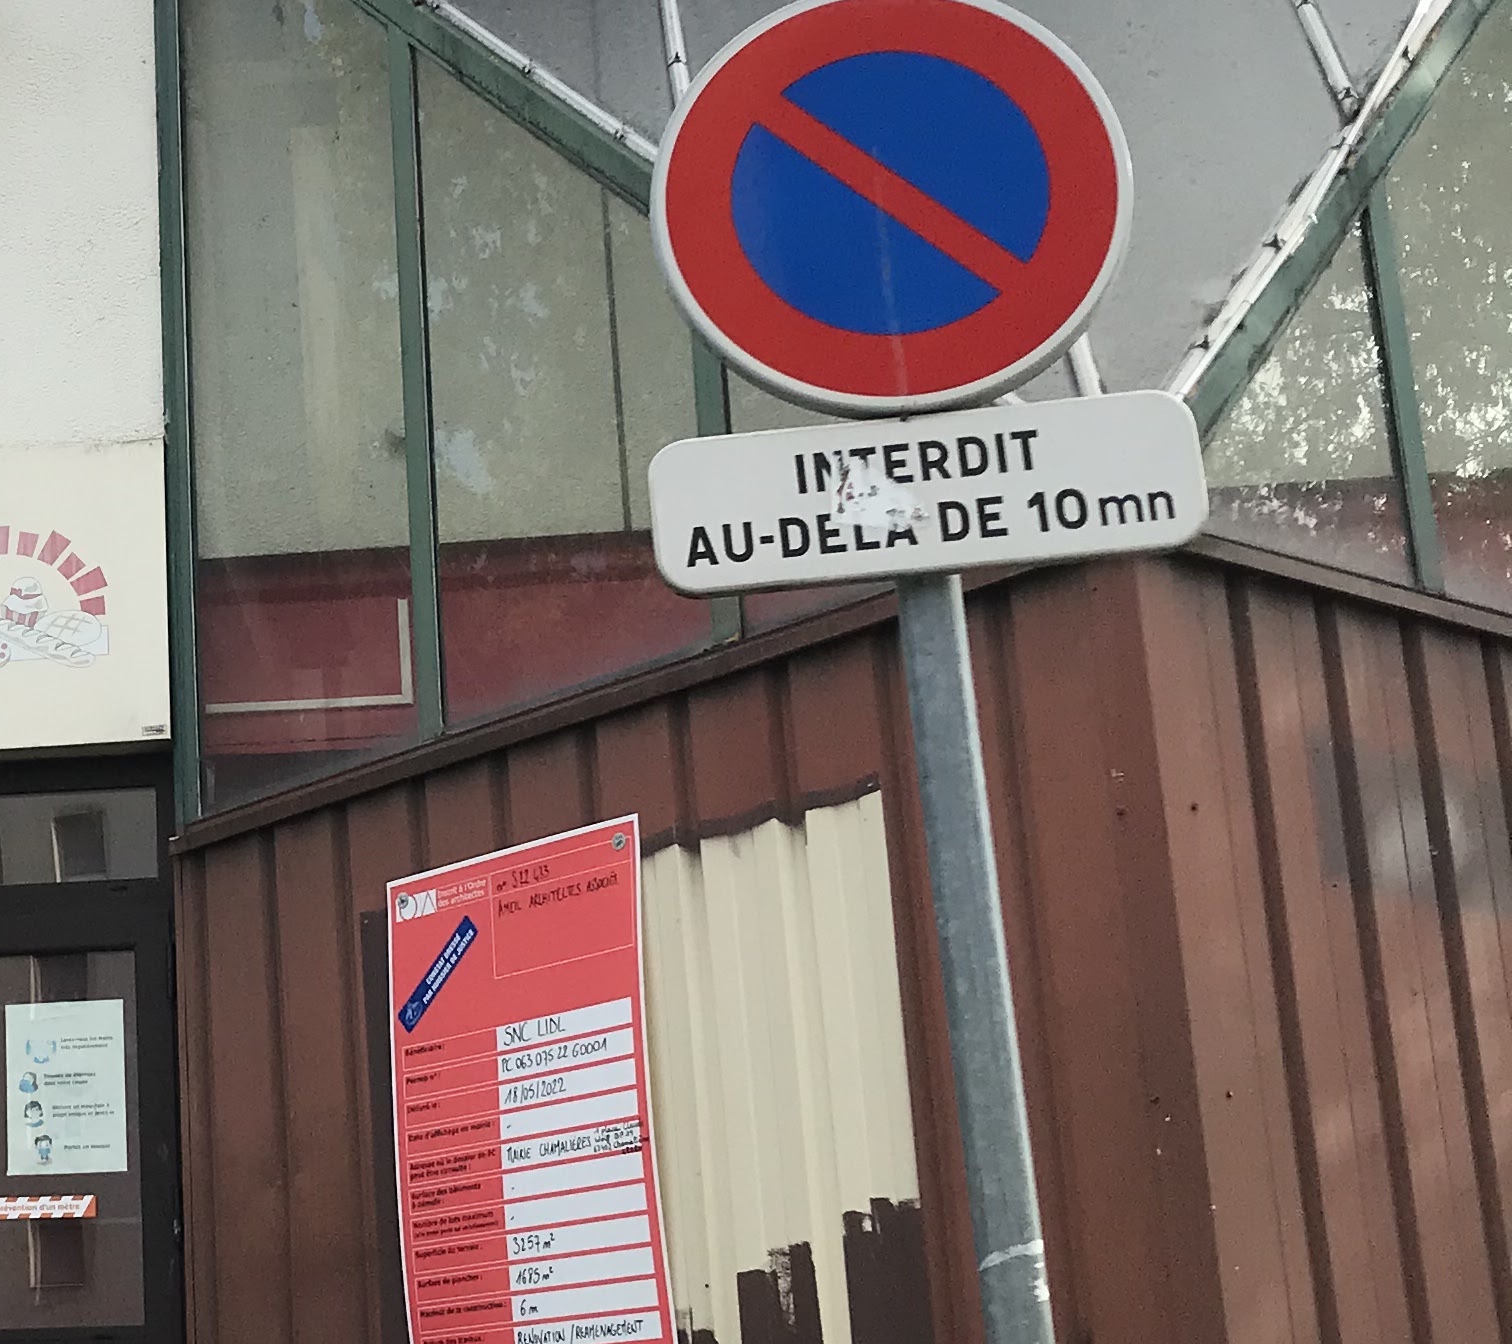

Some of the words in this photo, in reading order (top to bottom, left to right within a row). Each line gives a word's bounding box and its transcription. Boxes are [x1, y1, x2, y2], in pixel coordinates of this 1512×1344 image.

[938, 495, 1008, 543] DE
[503, 1022, 532, 1047] SNC
[537, 1016, 566, 1037] LIDL
[501, 1057, 513, 1073] PC
[535, 1048, 554, 1066] 075
[557, 1044, 568, 1060] 22
[39, 1203, 56, 1211] d'un
